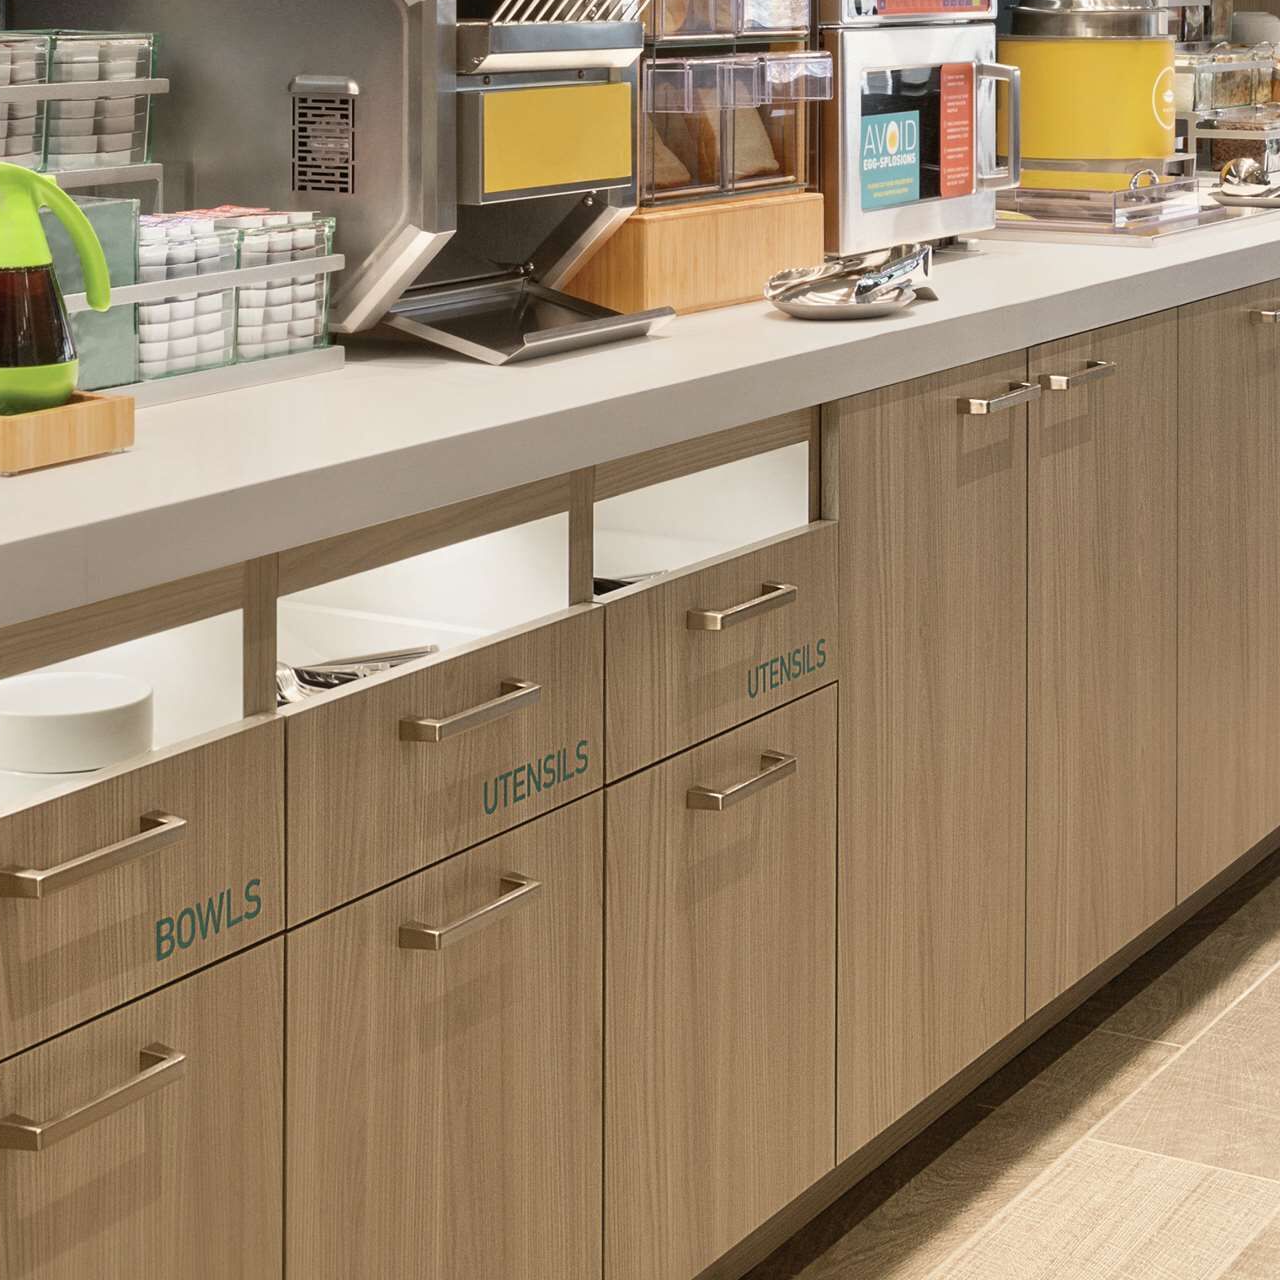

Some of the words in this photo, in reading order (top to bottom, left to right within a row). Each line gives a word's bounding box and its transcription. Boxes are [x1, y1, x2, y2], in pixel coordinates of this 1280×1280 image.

[863, 120, 918, 157] AVOID
[863, 152, 917, 171] EGG-SPLOSIONS
[746, 638, 827, 699] UTENSILS
[482, 739, 590, 815] UTENSILS
[155, 878, 263, 961] BOWLS
